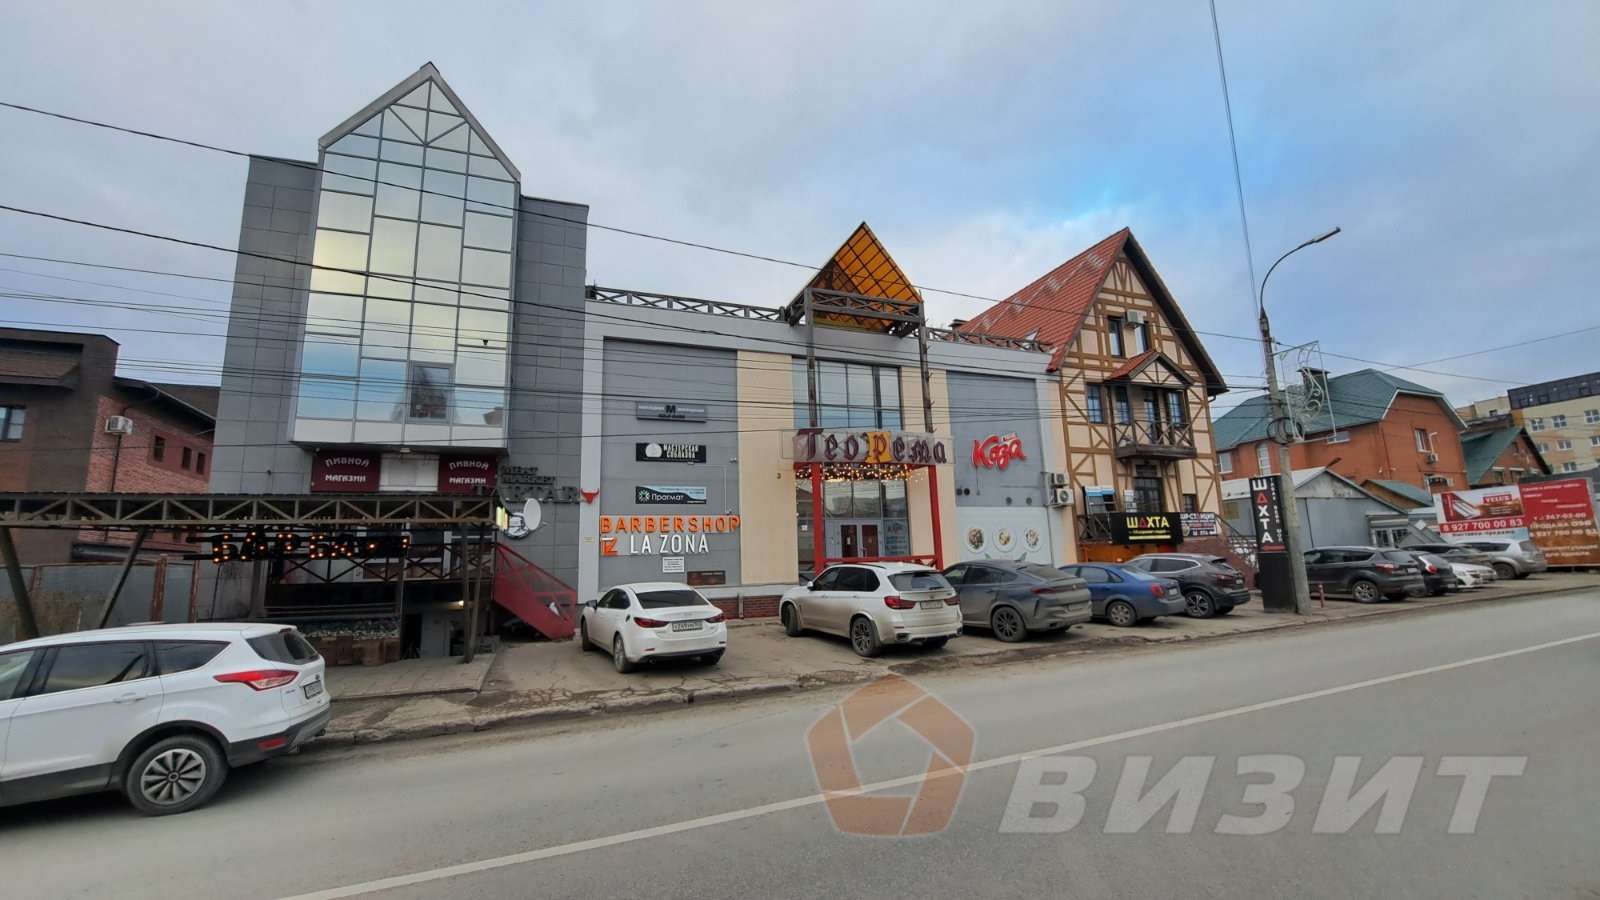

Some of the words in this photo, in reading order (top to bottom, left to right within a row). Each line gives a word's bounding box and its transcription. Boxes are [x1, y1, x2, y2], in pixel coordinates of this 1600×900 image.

[325, 457, 370, 467] ПИВНОЙ
[448, 459, 489, 470] ПИВНОЙ
[325, 474, 367, 483] МАГАЗИН
[449, 476, 487, 484] МАГАЗИН
[651, 493, 684, 501] Прагмат
[600, 515, 741, 534] BARBERSHOP
[1472, 521, 1490, 530] 700
[629, 535, 652, 553] LA
[659, 534, 709, 554] ZONA
